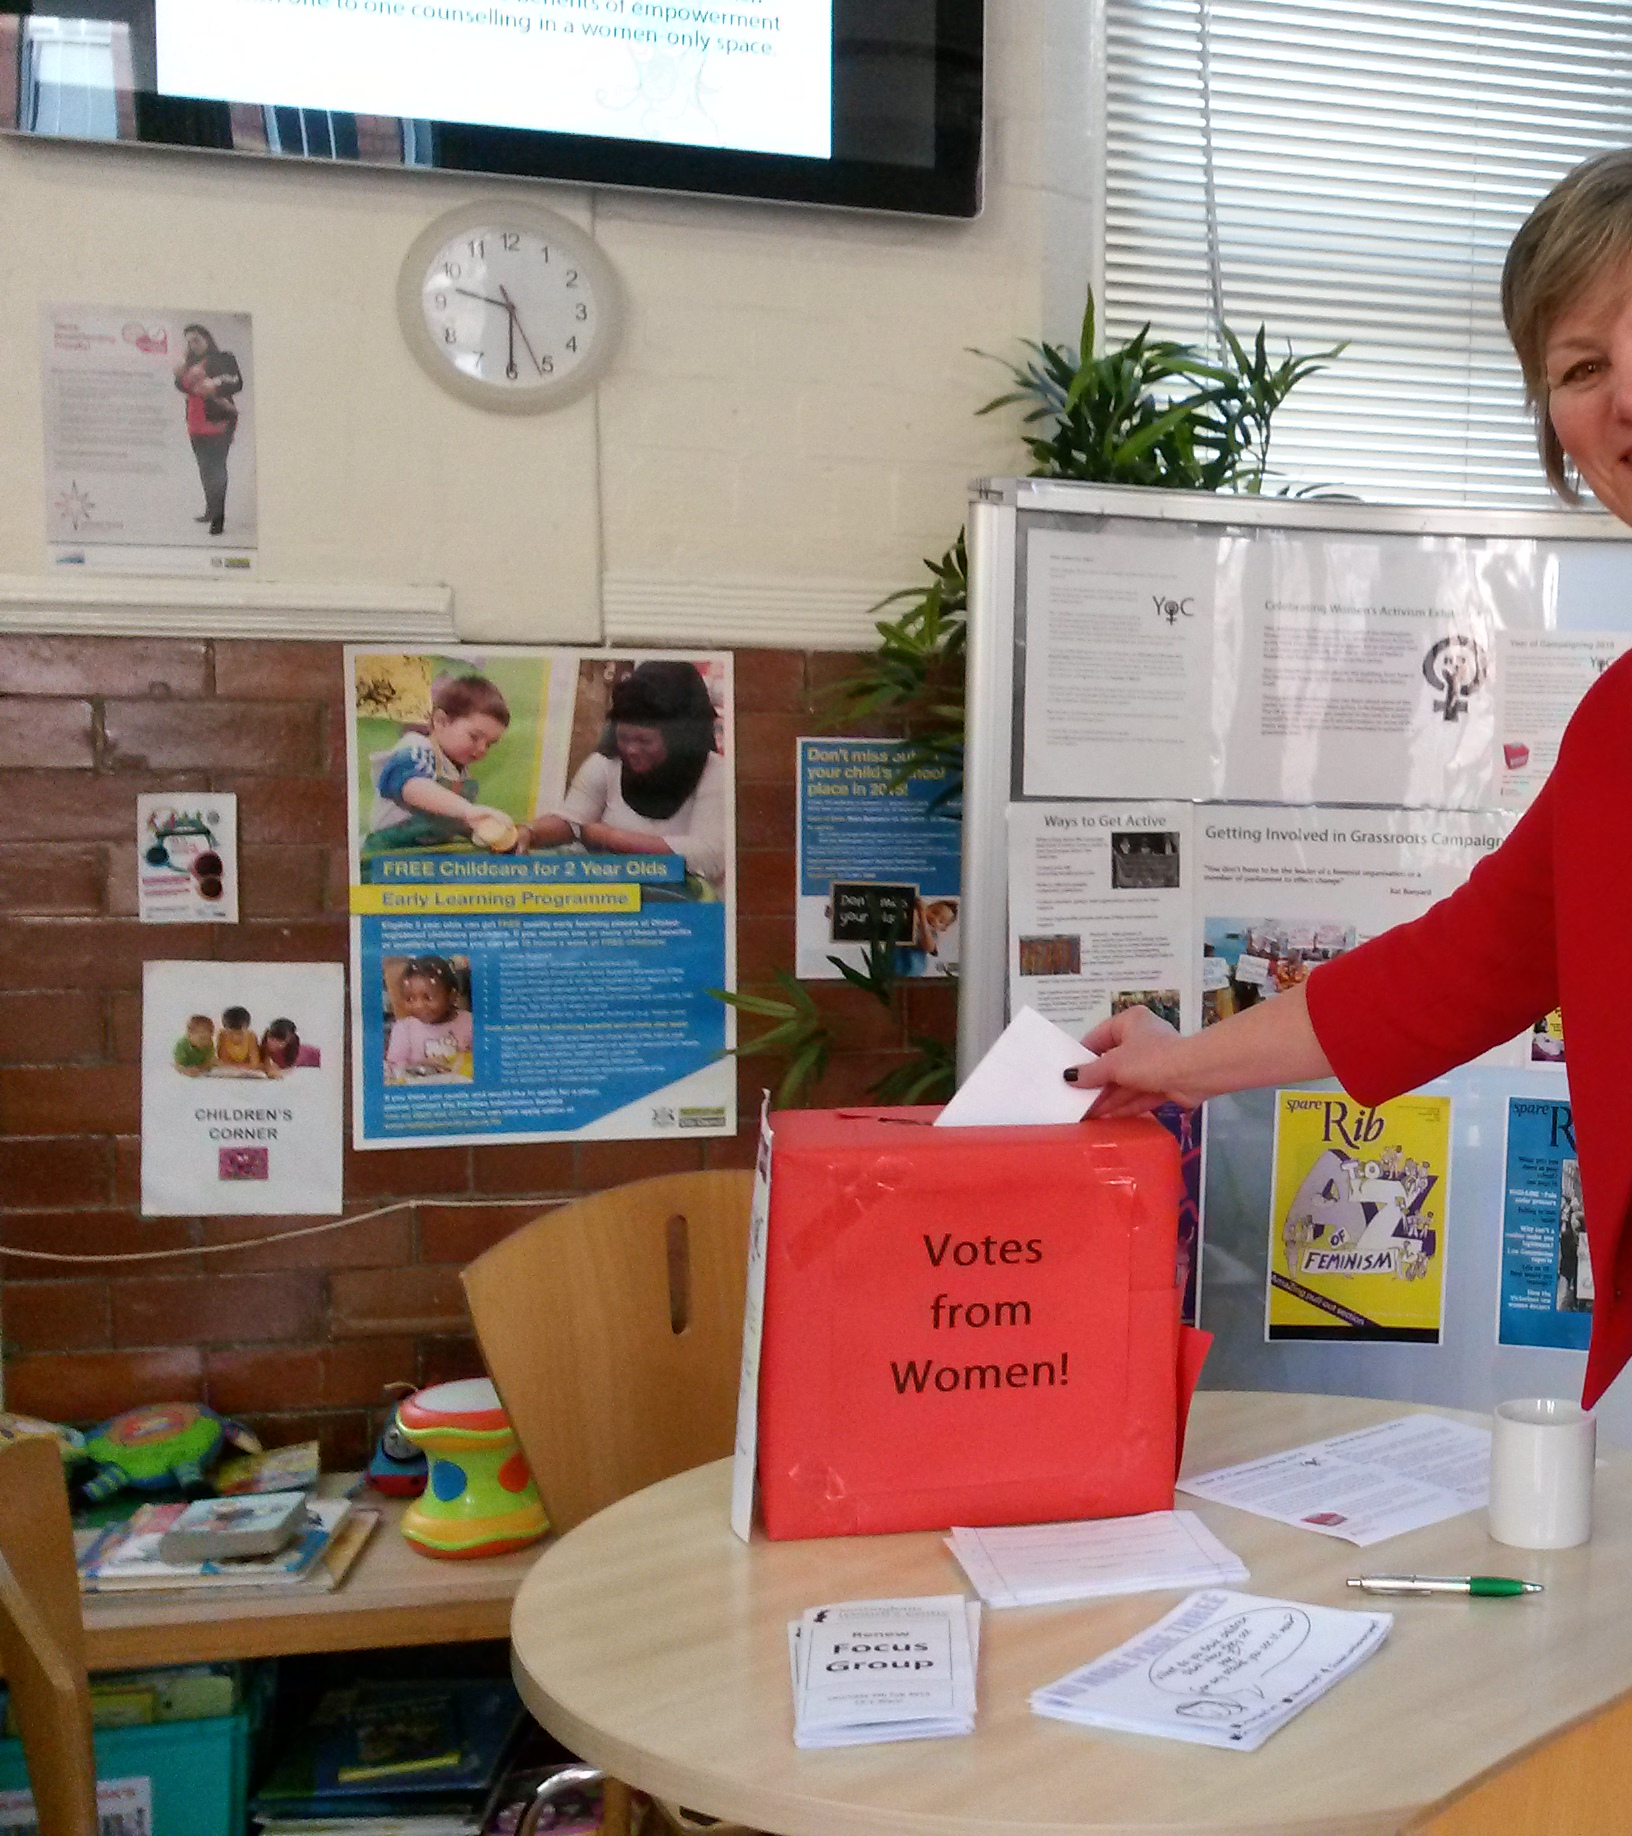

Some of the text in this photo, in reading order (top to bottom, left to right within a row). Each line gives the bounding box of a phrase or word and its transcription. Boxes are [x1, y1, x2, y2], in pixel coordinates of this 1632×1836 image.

[364, 1, 405, 17] one
[411, 3, 531, 33] counselling
[539, 13, 556, 31] in
[563, 19, 575, 34] a
[631, 2, 780, 31] empowerment
[469, 240, 485, 259] 11
[501, 232, 520, 252] 12
[541, 245, 549, 264] 1
[443, 261, 461, 280] 10
[565, 270, 578, 289] 2
[434, 293, 448, 311] 9
[574, 302, 588, 321] 3
[444, 327, 457, 345] 8
[565, 335, 578, 353] 4
[472, 350, 484, 368] 7
[542, 355, 554, 374] 5
[505, 361, 519, 381] 6
[1379, 605, 1426, 618] Activism
[807, 746, 849, 762] Don't
[853, 749, 888, 763] miss
[807, 767, 841, 781] your
[844, 765, 893, 779] child's
[807, 782, 849, 798] place
[1044, 814, 1167, 829] Ways to Get Active
[1205, 825, 1262, 844] Getting
[1266, 827, 1329, 842] Involved
[1333, 828, 1347, 842] in
[1350, 829, 1428, 845] Grassroots
[383, 860, 668, 877] FREE Childcare for 2 Year Olds
[382, 890, 629, 909] Early Learning Programme
[194, 1107, 293, 1123] CHILDREN'S
[1285, 1099, 1323, 1113] spare
[1514, 1103, 1550, 1118] spare
[208, 1126, 279, 1142] CORNER
[1321, 1100, 1386, 1150] Rib
[1329, 1228, 1347, 1247] OF
[923, 1233, 1043, 1267] Votes
[1303, 1251, 1393, 1271] FEMINISM
[930, 1293, 1032, 1329] from
[890, 1352, 1069, 1394] Women!
[833, 1642, 929, 1655] Focus
[825, 1660, 934, 1673] Group
